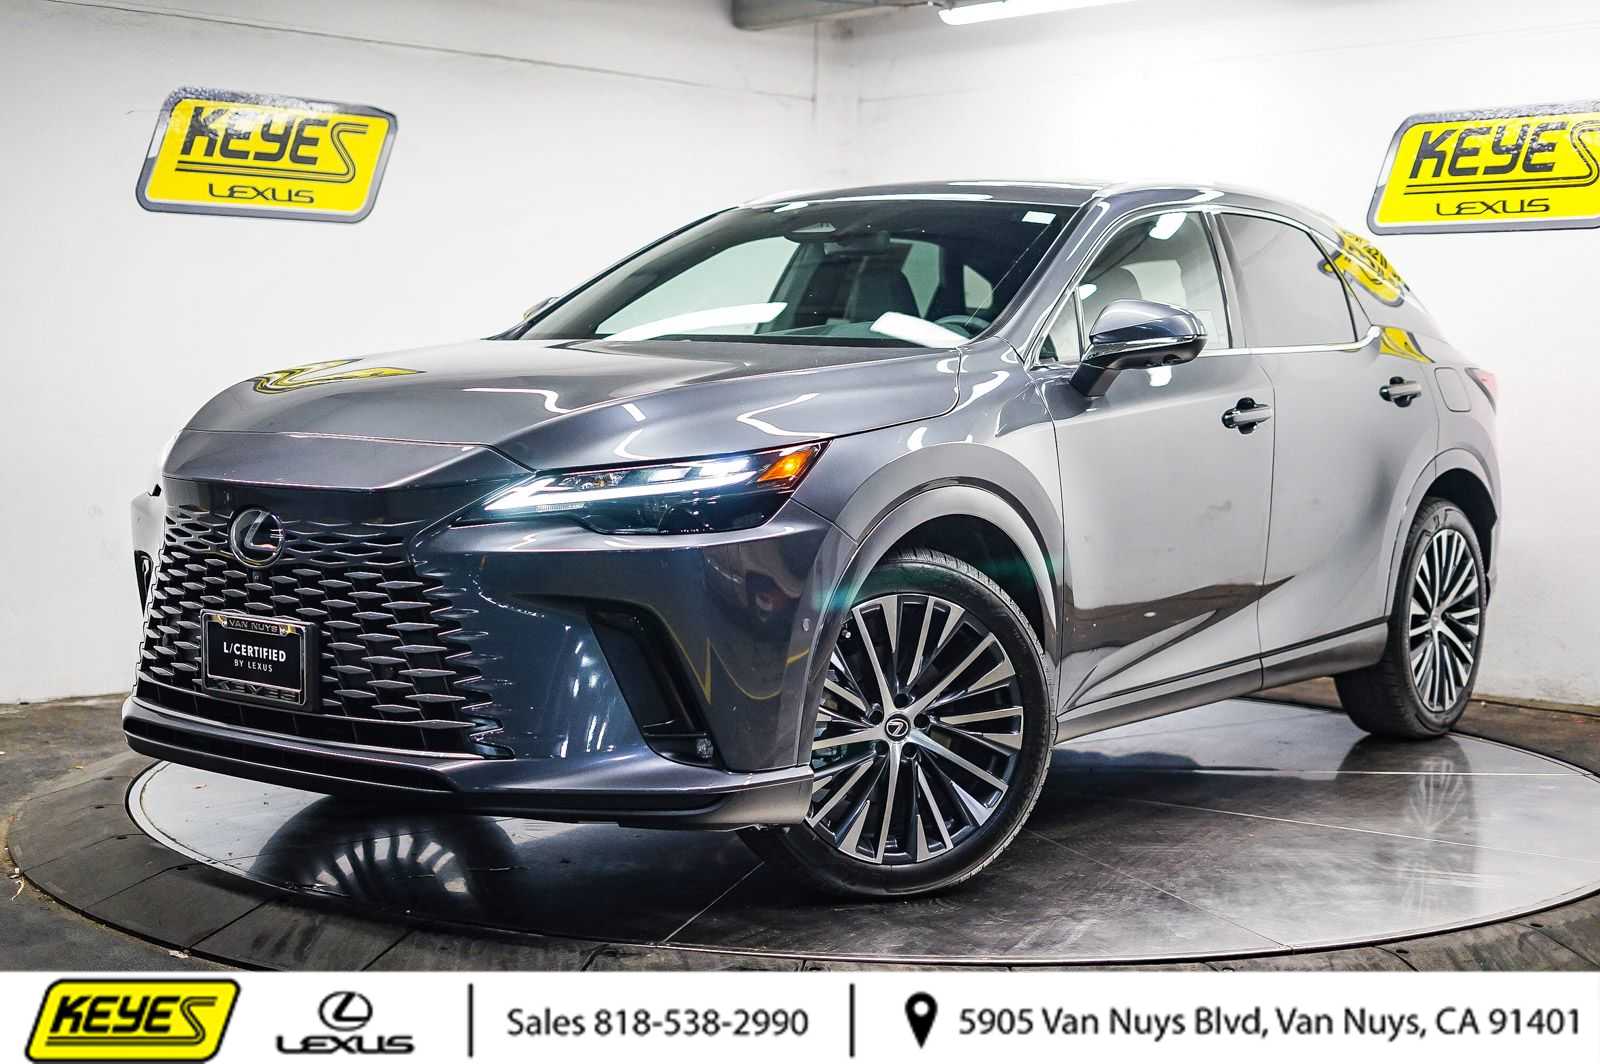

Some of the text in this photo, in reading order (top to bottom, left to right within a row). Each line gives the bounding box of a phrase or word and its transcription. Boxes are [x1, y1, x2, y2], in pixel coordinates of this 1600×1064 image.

[178, 106, 369, 183] KEYES
[1408, 120, 1600, 187] KEYES
[208, 184, 315, 204] LEXUS
[1436, 198, 1550, 216] LEXUS
[229, 618, 278, 633] VAN NUYS
[223, 641, 287, 662] L/CERTIFIED
[234, 658, 273, 673] BY LEXUS
